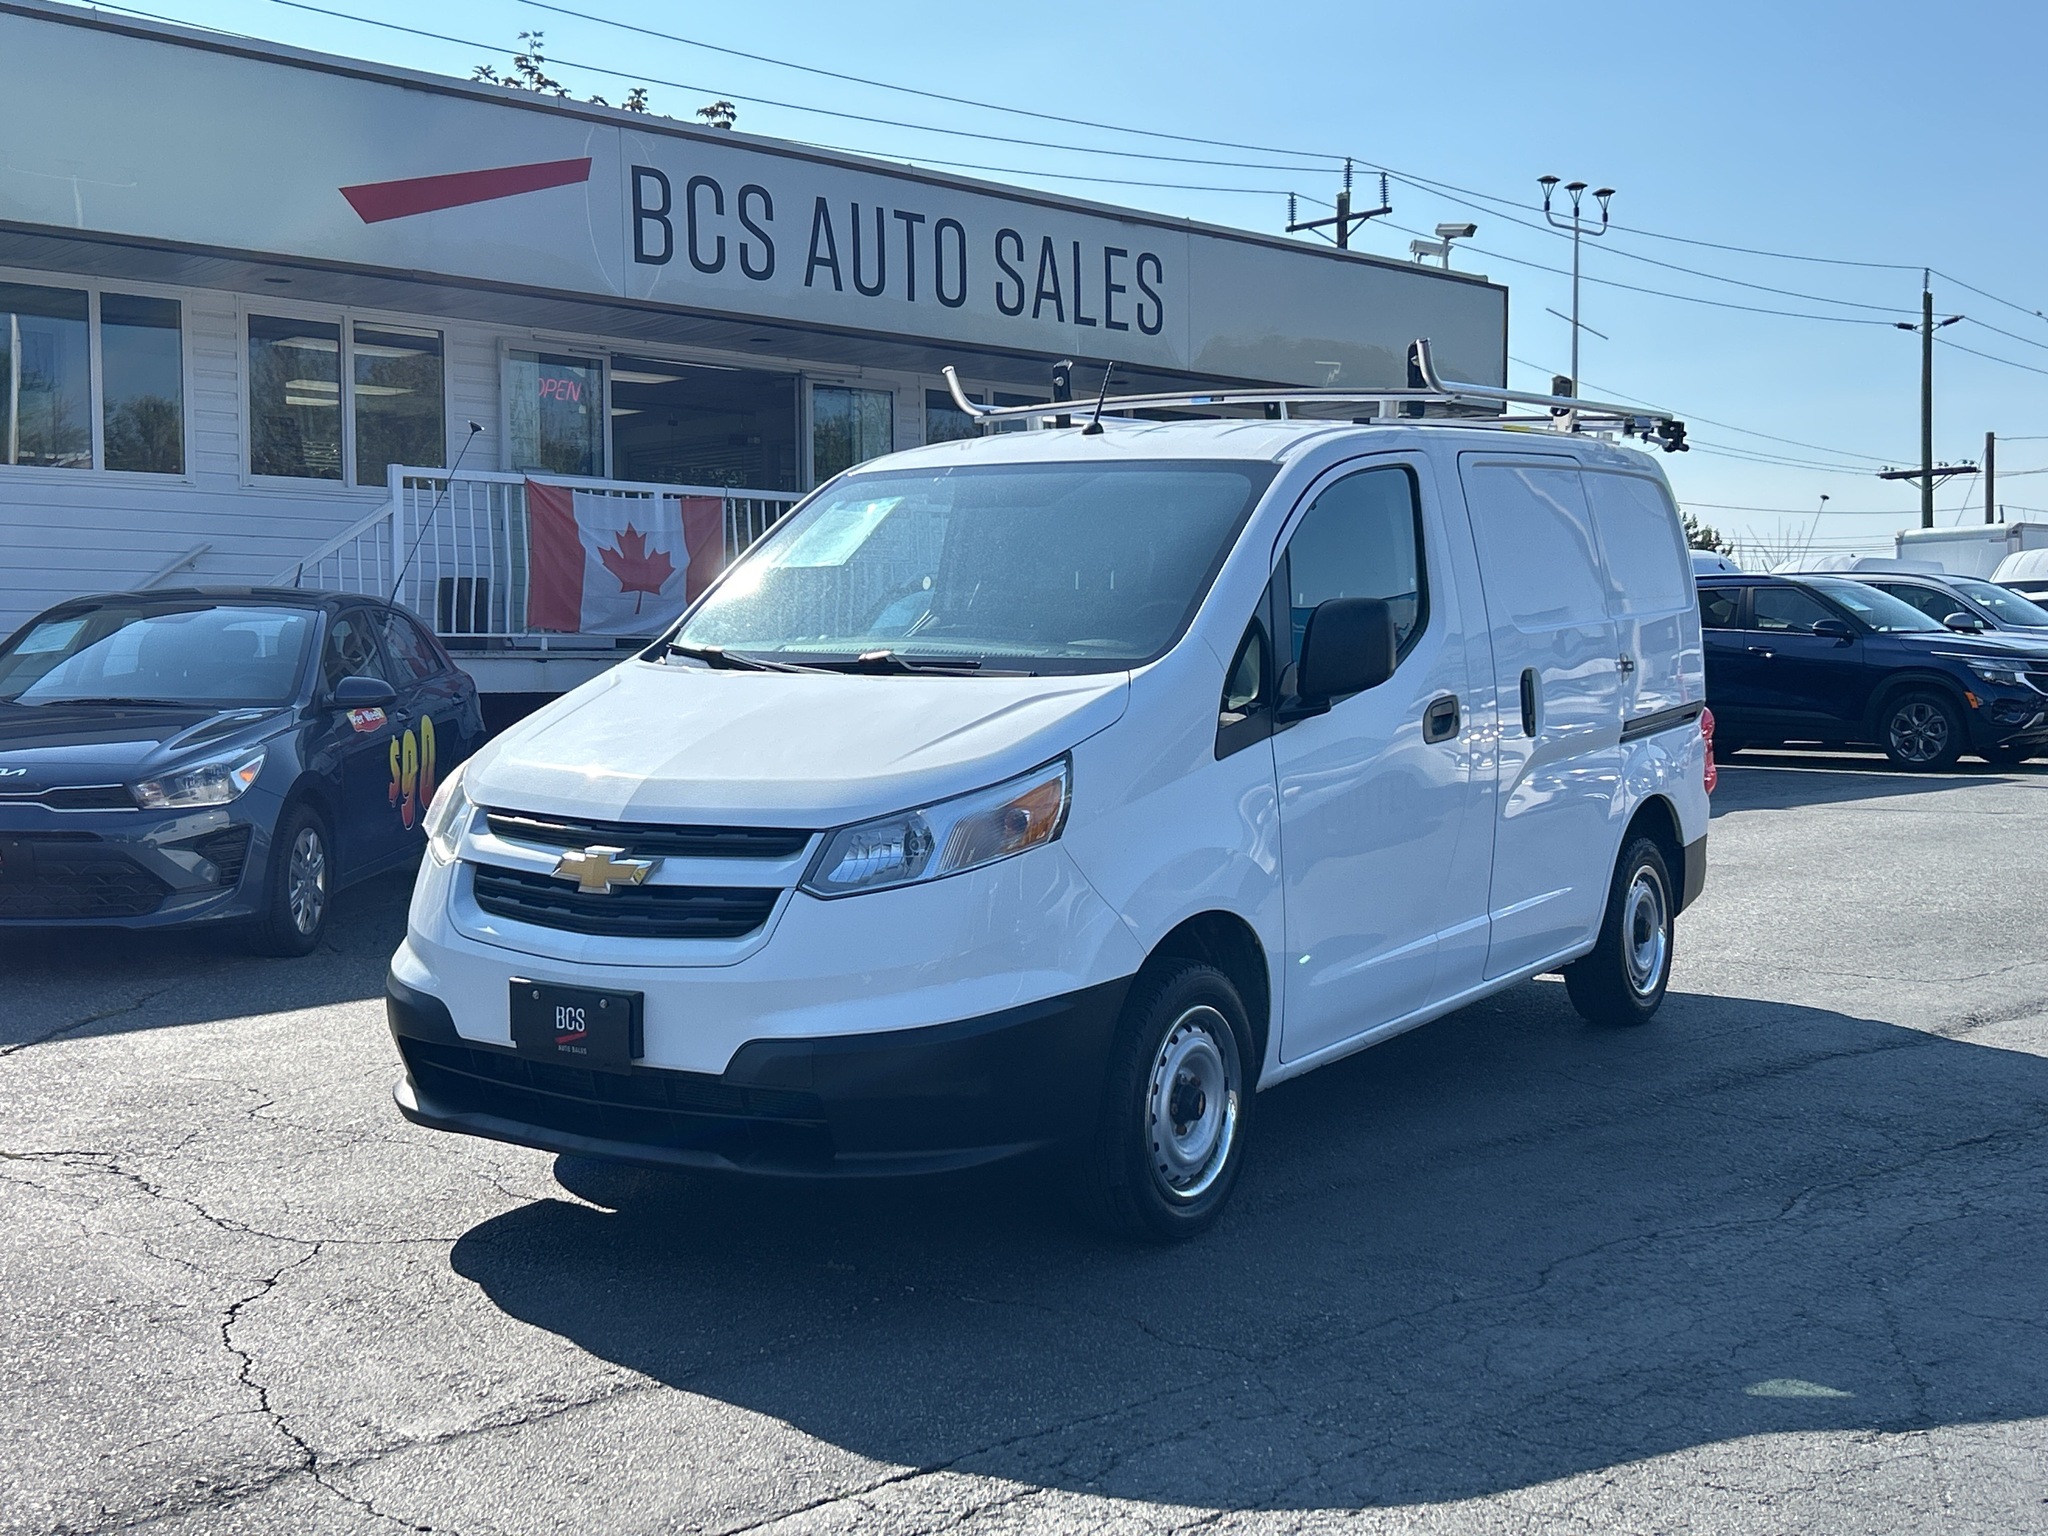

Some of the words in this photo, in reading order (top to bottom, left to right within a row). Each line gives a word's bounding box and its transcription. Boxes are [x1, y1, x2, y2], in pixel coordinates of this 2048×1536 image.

[631, 164, 775, 281] BCS
[804, 196, 966, 308] AUTO
[994, 228, 1162, 336] SALES
[556, 1006, 585, 1032] BCS
